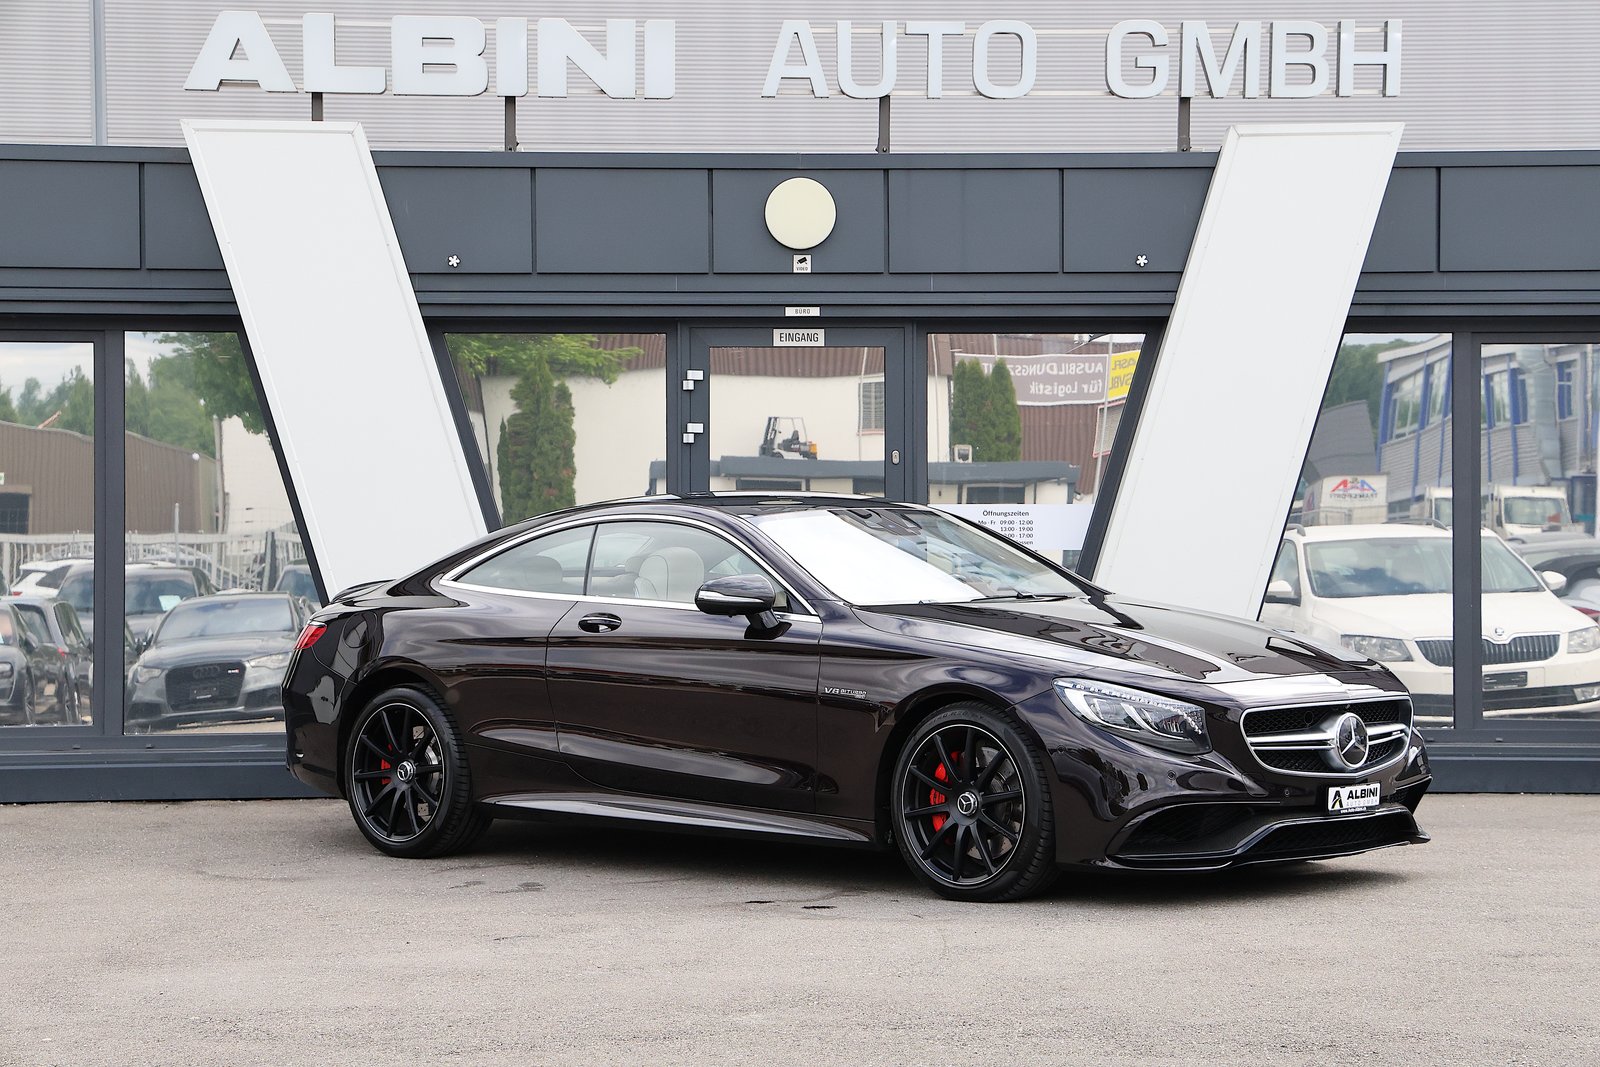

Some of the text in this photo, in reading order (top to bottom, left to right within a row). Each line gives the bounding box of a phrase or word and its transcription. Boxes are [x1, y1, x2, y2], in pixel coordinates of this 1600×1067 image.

[184, 11, 1403, 100] ALBINI AUTO GMBH
[779, 332, 819, 343] EINGANG
[1347, 787, 1378, 800] ALBINI
